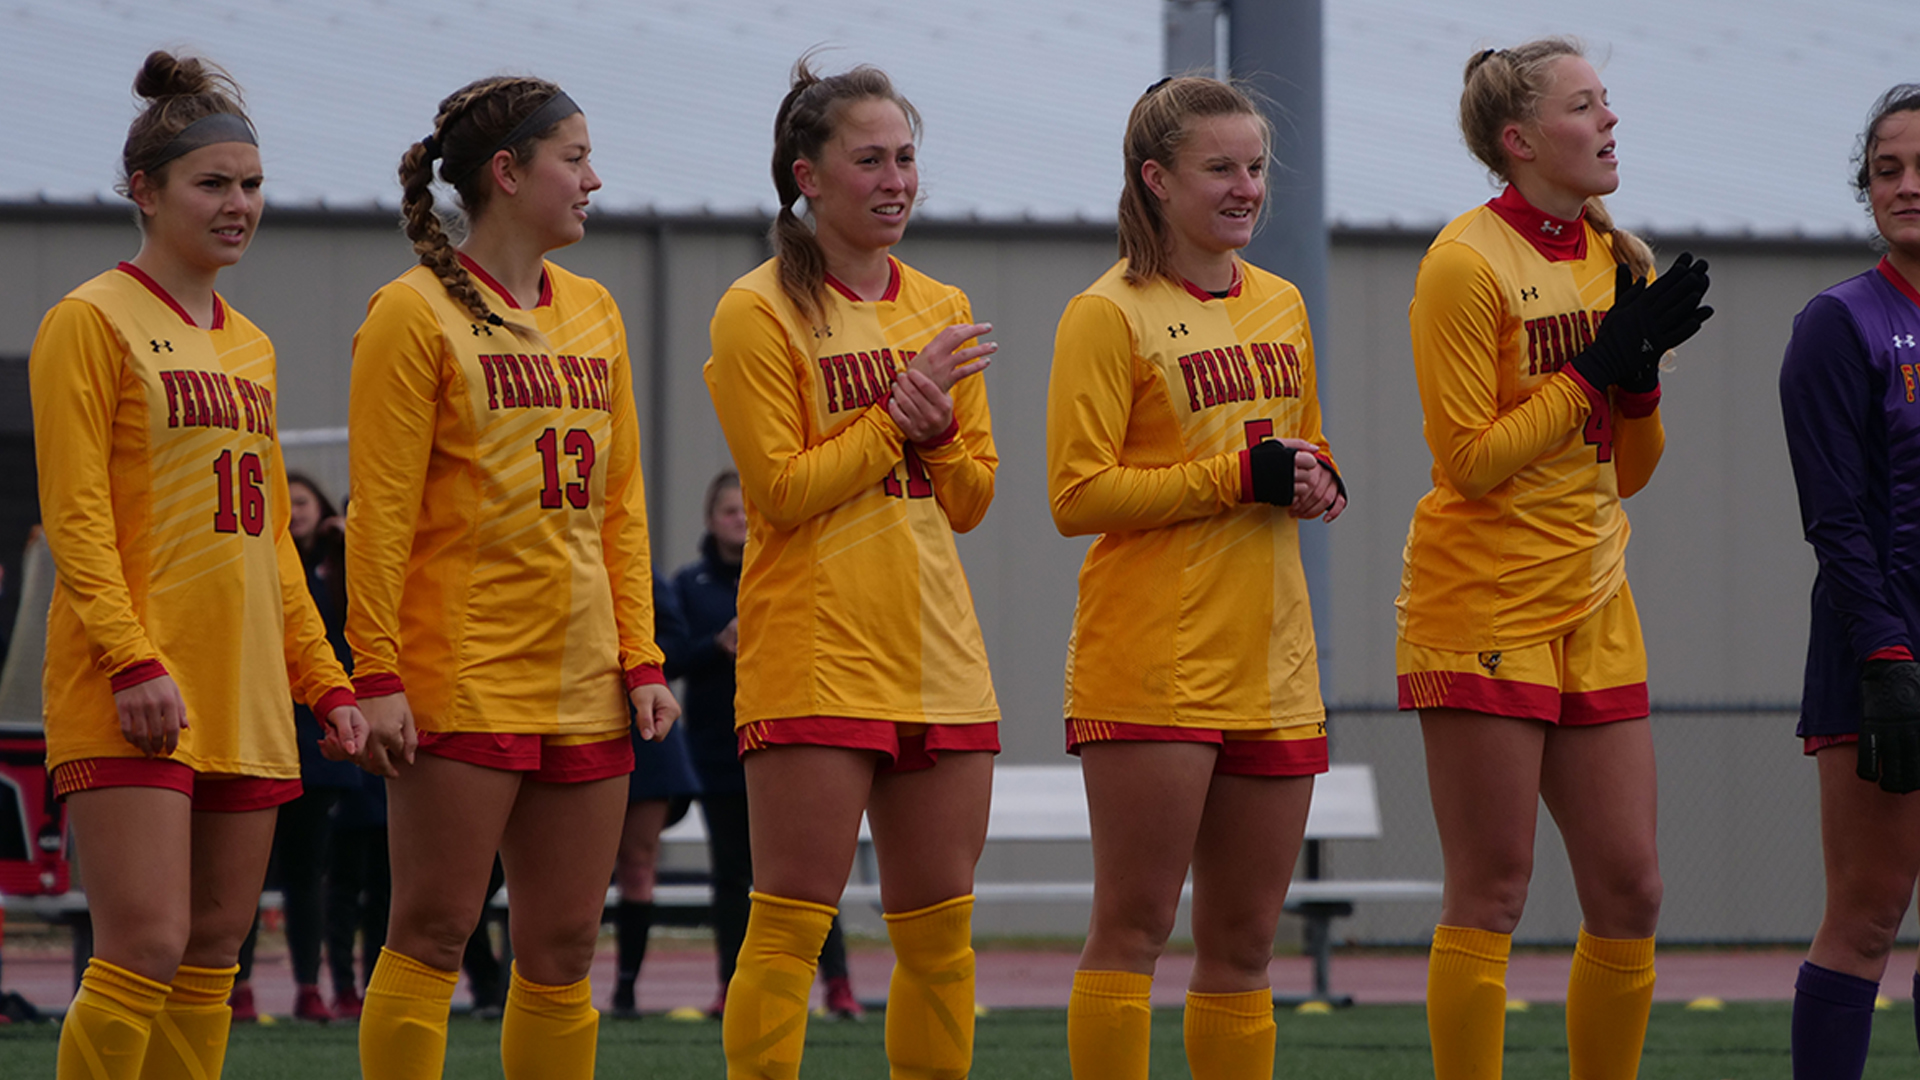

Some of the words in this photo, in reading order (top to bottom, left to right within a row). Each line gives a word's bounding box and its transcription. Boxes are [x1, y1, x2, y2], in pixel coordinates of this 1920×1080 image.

[1524, 310, 1593, 375] FERRIS
[159, 371, 239, 430] FERRIS
[234, 376, 274, 442] STAT
[478, 354, 562, 410] FERRIS
[818, 348, 897, 414] FERRIS
[1178, 346, 1256, 412] FERRIS
[1583, 402, 1613, 463] 4
[213, 449, 265, 537] 16
[535, 428, 595, 509] 13
[884, 440, 933, 498] 1
